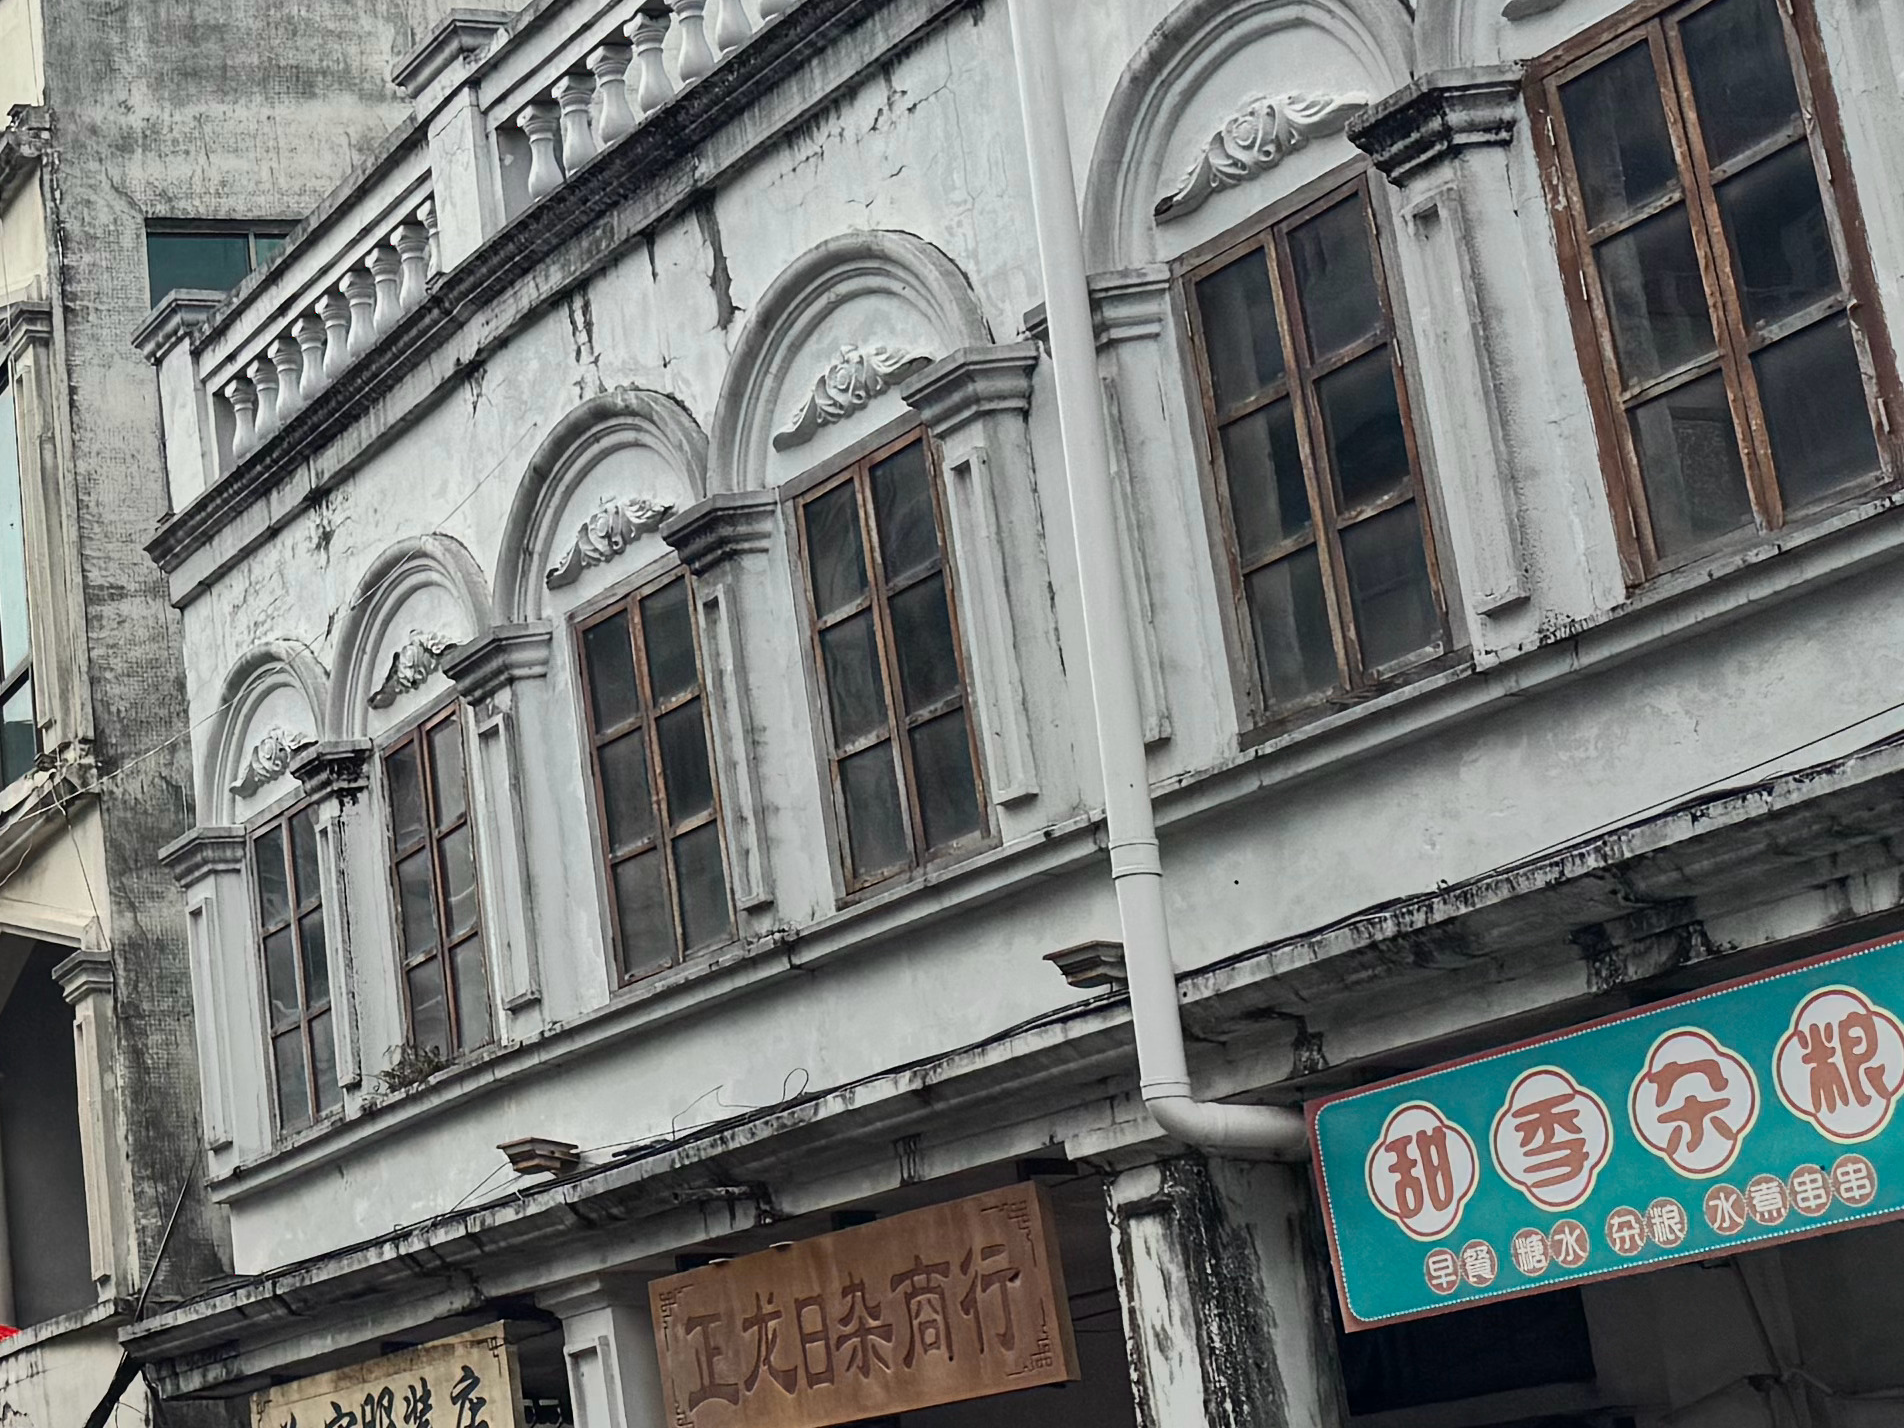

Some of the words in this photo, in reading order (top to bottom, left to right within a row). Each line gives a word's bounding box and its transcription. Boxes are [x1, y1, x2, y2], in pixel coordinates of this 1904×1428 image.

[1388, 1012, 1890, 1221] 甜季杂粮
[1427, 1240, 1496, 1289] 早餐
[1516, 1222, 1587, 1273] 糖水
[1610, 1200, 1684, 1246] 杂粮
[1709, 1160, 1874, 1229] 水煮串串
[686, 1244, 1021, 1406] 正龙日杂商行
